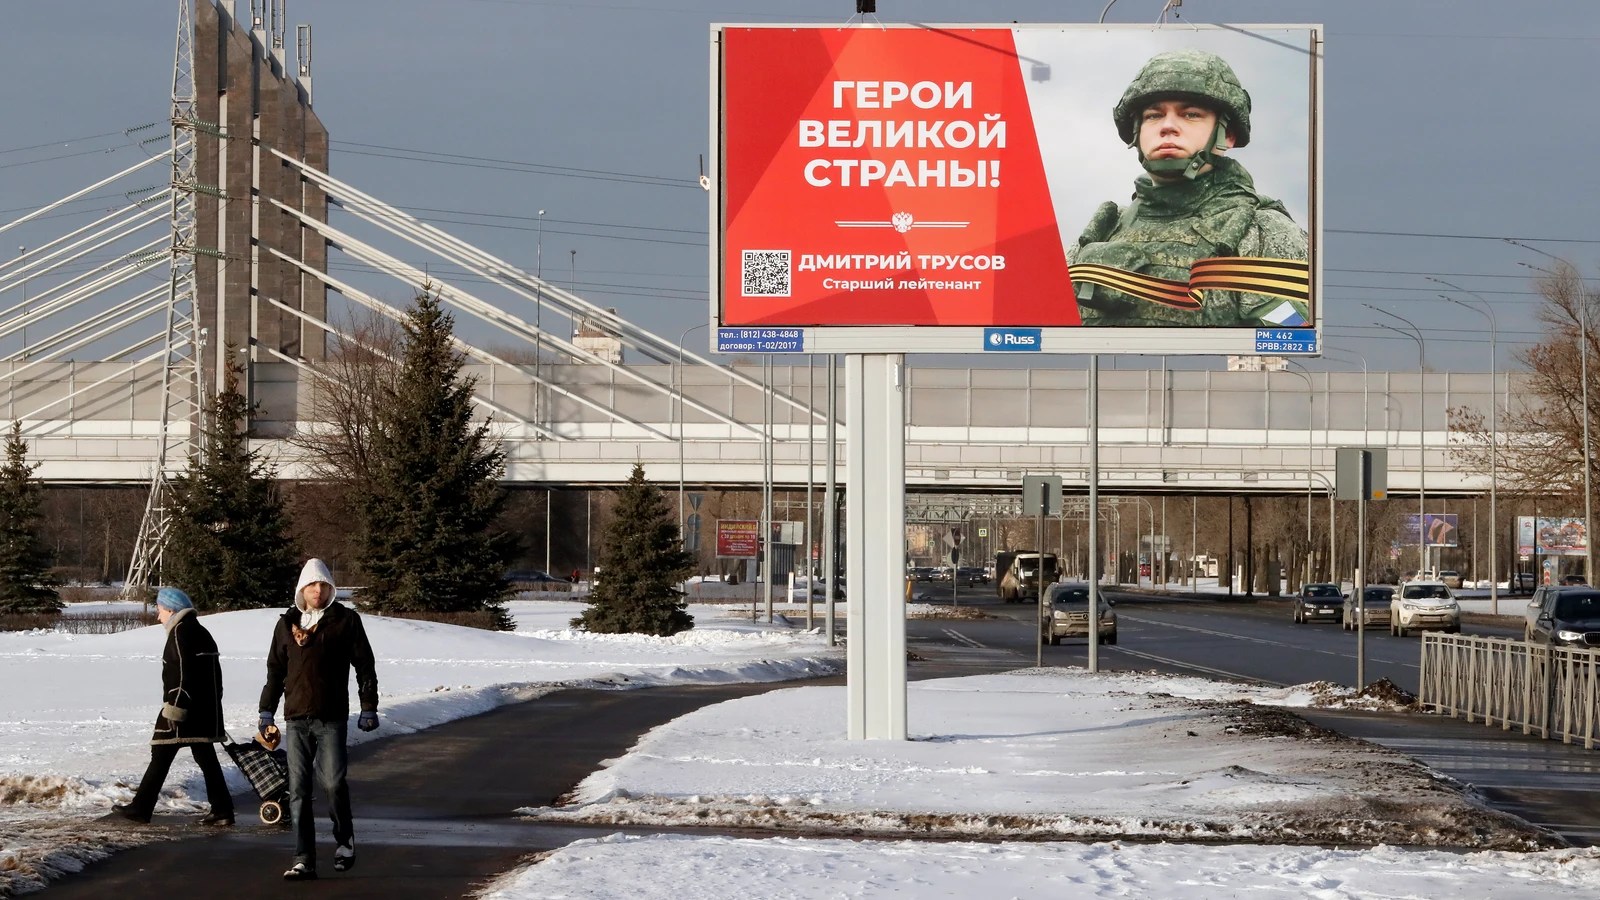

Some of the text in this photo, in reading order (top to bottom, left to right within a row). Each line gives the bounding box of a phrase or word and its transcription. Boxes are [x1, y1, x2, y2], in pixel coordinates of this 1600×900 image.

[833, 81, 973, 109] ГЕРОИ
[798, 113, 1006, 148] ВЕЛИКОЙ
[803, 159, 1001, 188] СТРАНЫ!
[798, 251, 1006, 272] ДМИТРИЙ ТРУСОВ
[822, 277, 982, 293] Старший лейтенант
[740, 330, 760, 338] (812)
[762, 330, 798, 338] 438-4848
[1004, 333, 1035, 345] Russ
[720, 343, 755, 351] договор:
